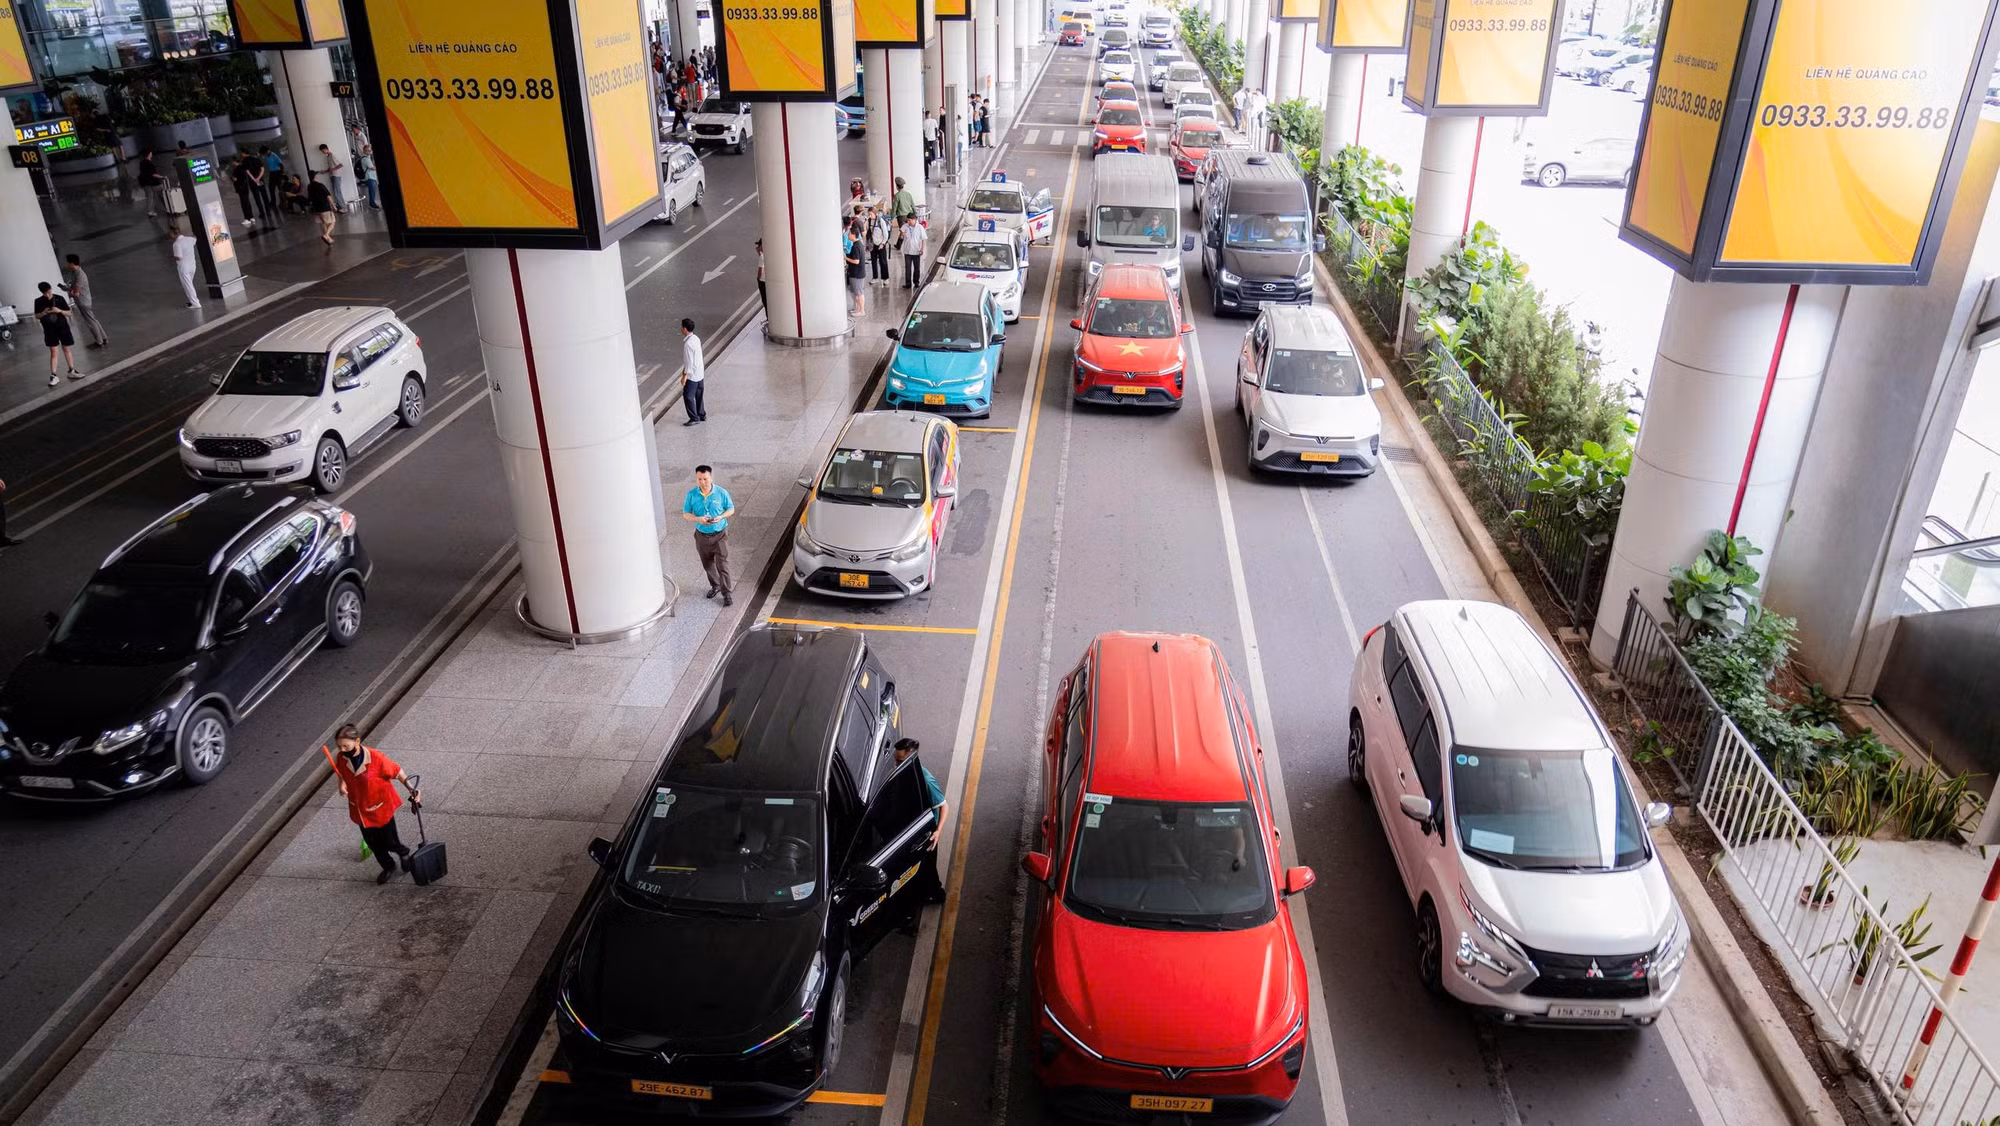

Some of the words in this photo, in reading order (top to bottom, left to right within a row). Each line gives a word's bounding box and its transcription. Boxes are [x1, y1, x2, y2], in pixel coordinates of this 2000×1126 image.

[727, 7, 818, 20] 0933.33.99.88
[1449, 19, 1547, 32] 0933.33.99.88
[408, 42, 433, 53] LIÊN
[436, 42, 450, 55] HỆ
[453, 40, 492, 53] QUẢNG
[494, 41, 518, 53] CÁO
[1805, 66, 1833, 79] LIÊN
[1836, 67, 1851, 80] HỆ
[340, 85, 350, 95] 07
[386, 78, 554, 100] 0933.33.99.88
[1655, 85, 1723, 122] 0933.33.99.88
[1761, 104, 1950, 129] 0933.33.99.88
[23, 128, 35, 140] A2
[50, 123, 61, 135] A1
[21, 151, 38, 163] 08
[1137, 1097, 1206, 1110] 35H-097.27
